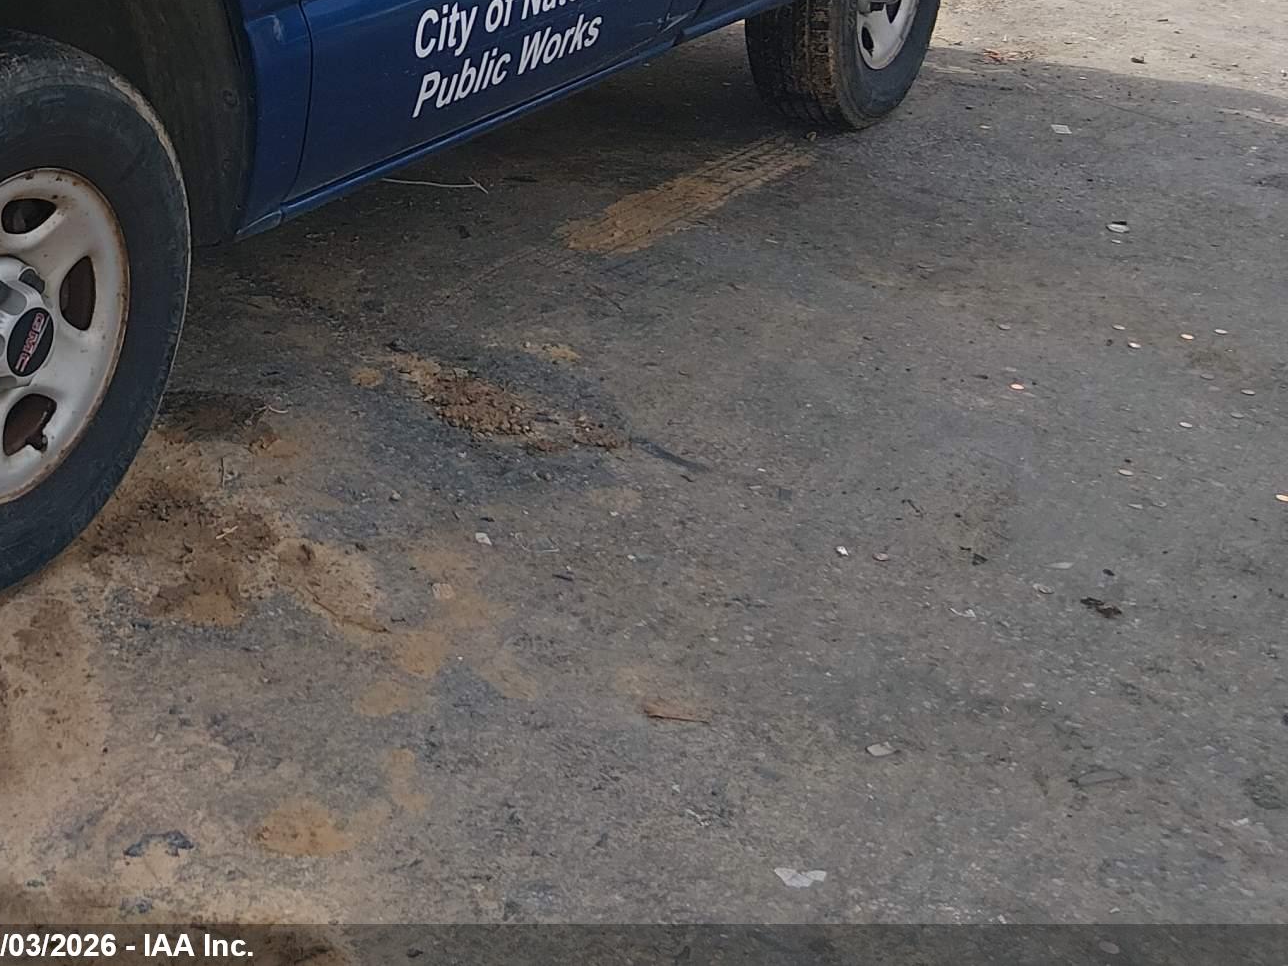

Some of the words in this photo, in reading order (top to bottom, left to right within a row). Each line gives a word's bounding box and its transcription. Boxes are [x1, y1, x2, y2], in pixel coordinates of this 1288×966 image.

[414, 2, 479, 59] City
[412, 47, 512, 119] Public
[517, 14, 603, 76] Works
[14, 312, 46, 373] GMC
